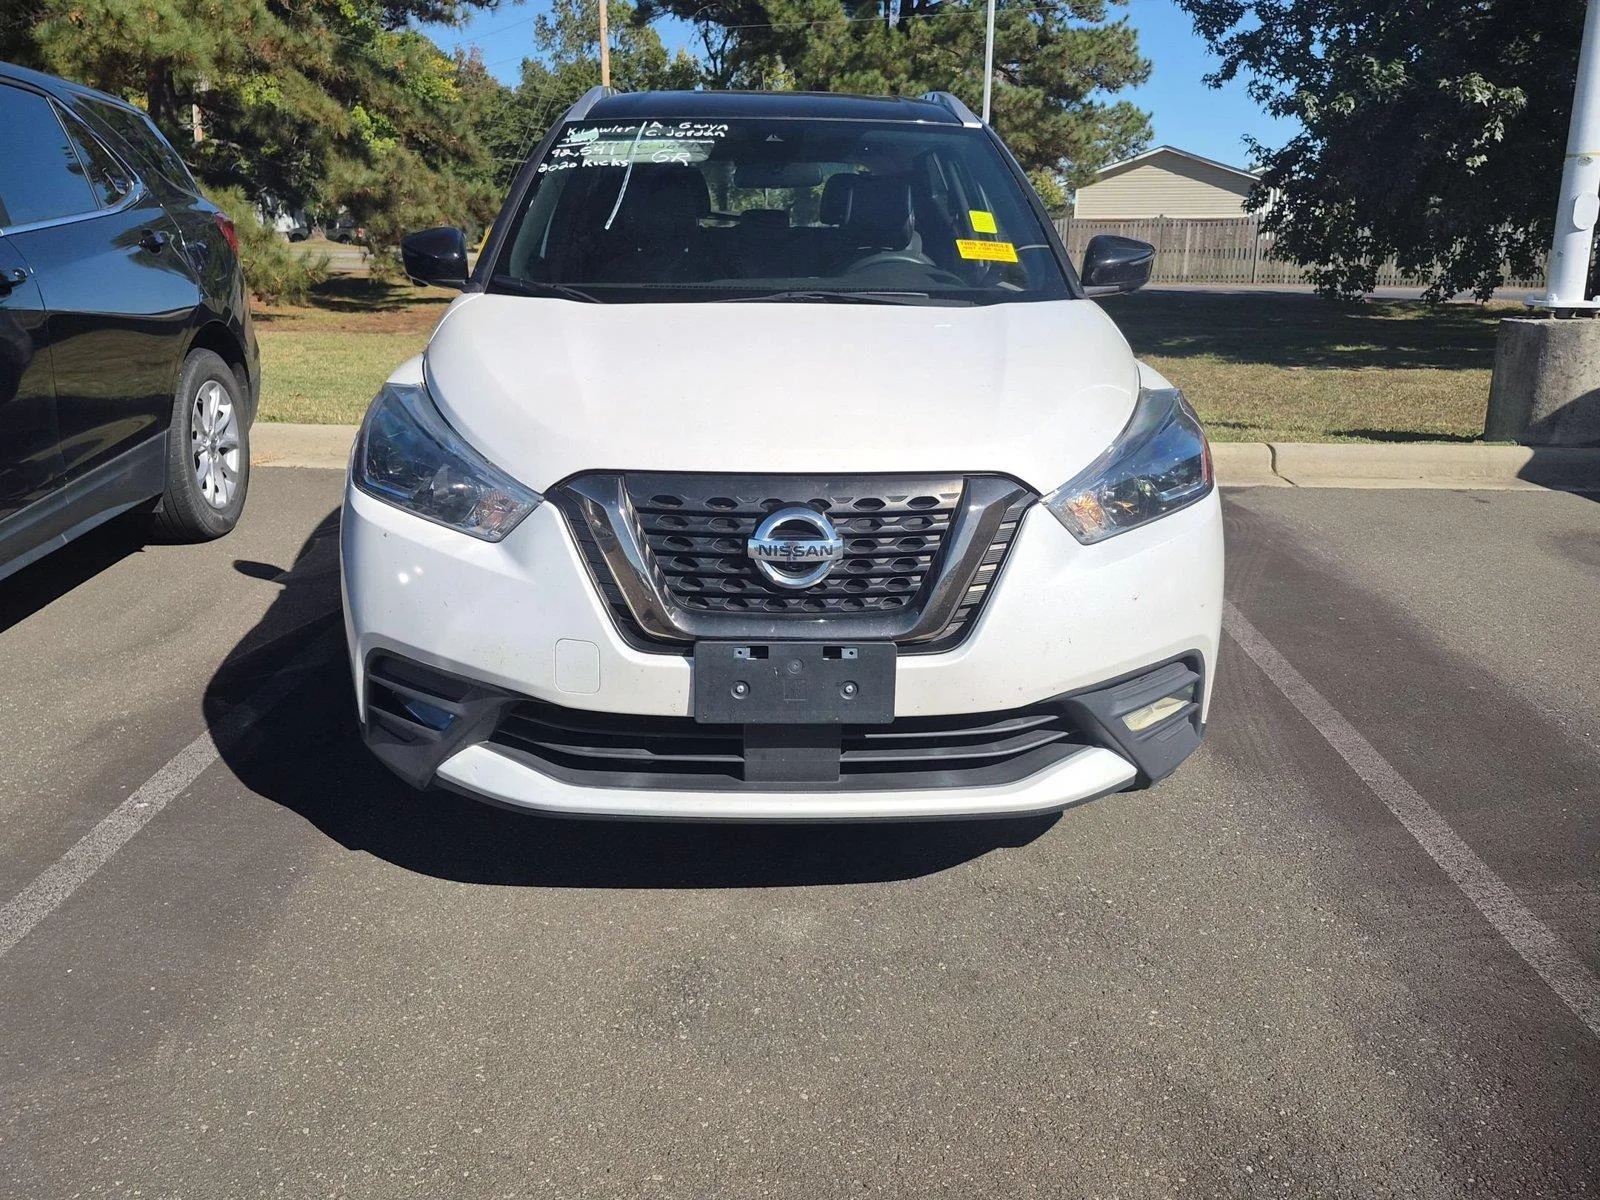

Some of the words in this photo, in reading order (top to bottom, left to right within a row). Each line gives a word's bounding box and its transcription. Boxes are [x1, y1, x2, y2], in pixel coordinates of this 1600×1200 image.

[551, 146, 616, 157] 92,541
[538, 161, 577, 172] 2020
[758, 544, 834, 557] NISSAN
